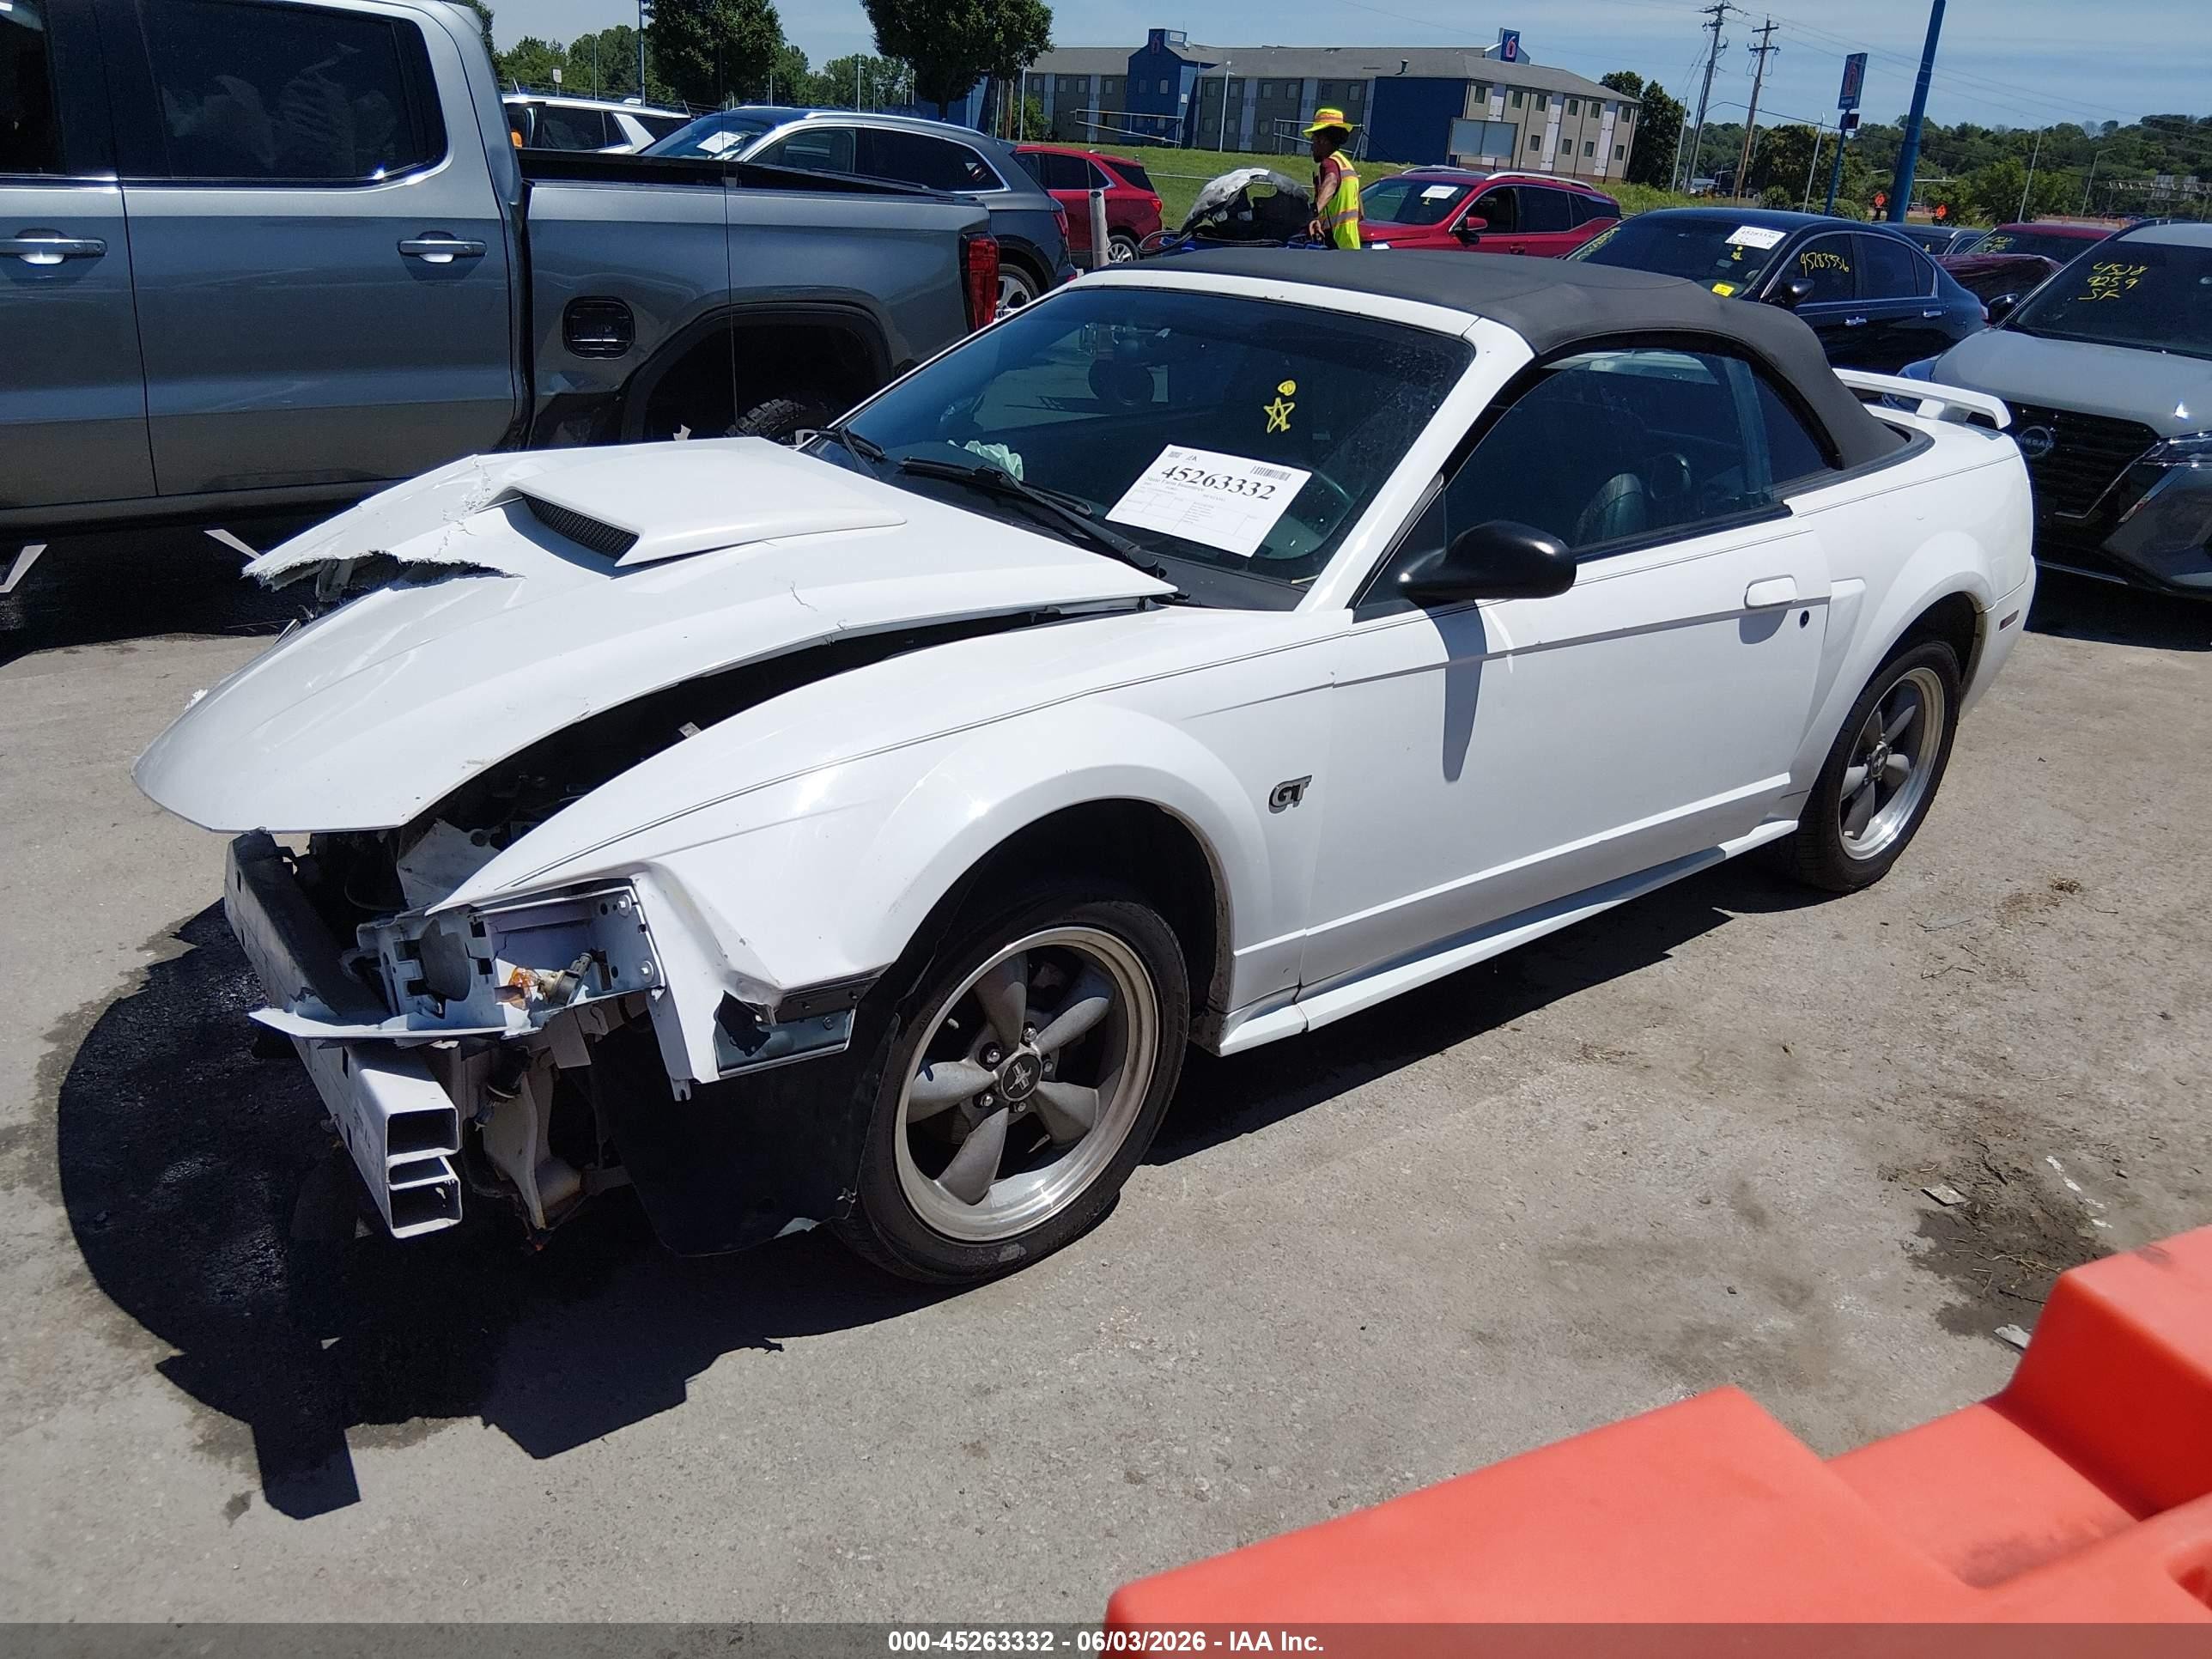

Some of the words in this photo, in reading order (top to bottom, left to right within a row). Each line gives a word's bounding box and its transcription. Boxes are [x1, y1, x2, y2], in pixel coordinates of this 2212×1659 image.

[1505, 36, 1516, 58] 6
[1161, 465, 1276, 500] 45263332
[1269, 775, 1313, 814] GT
